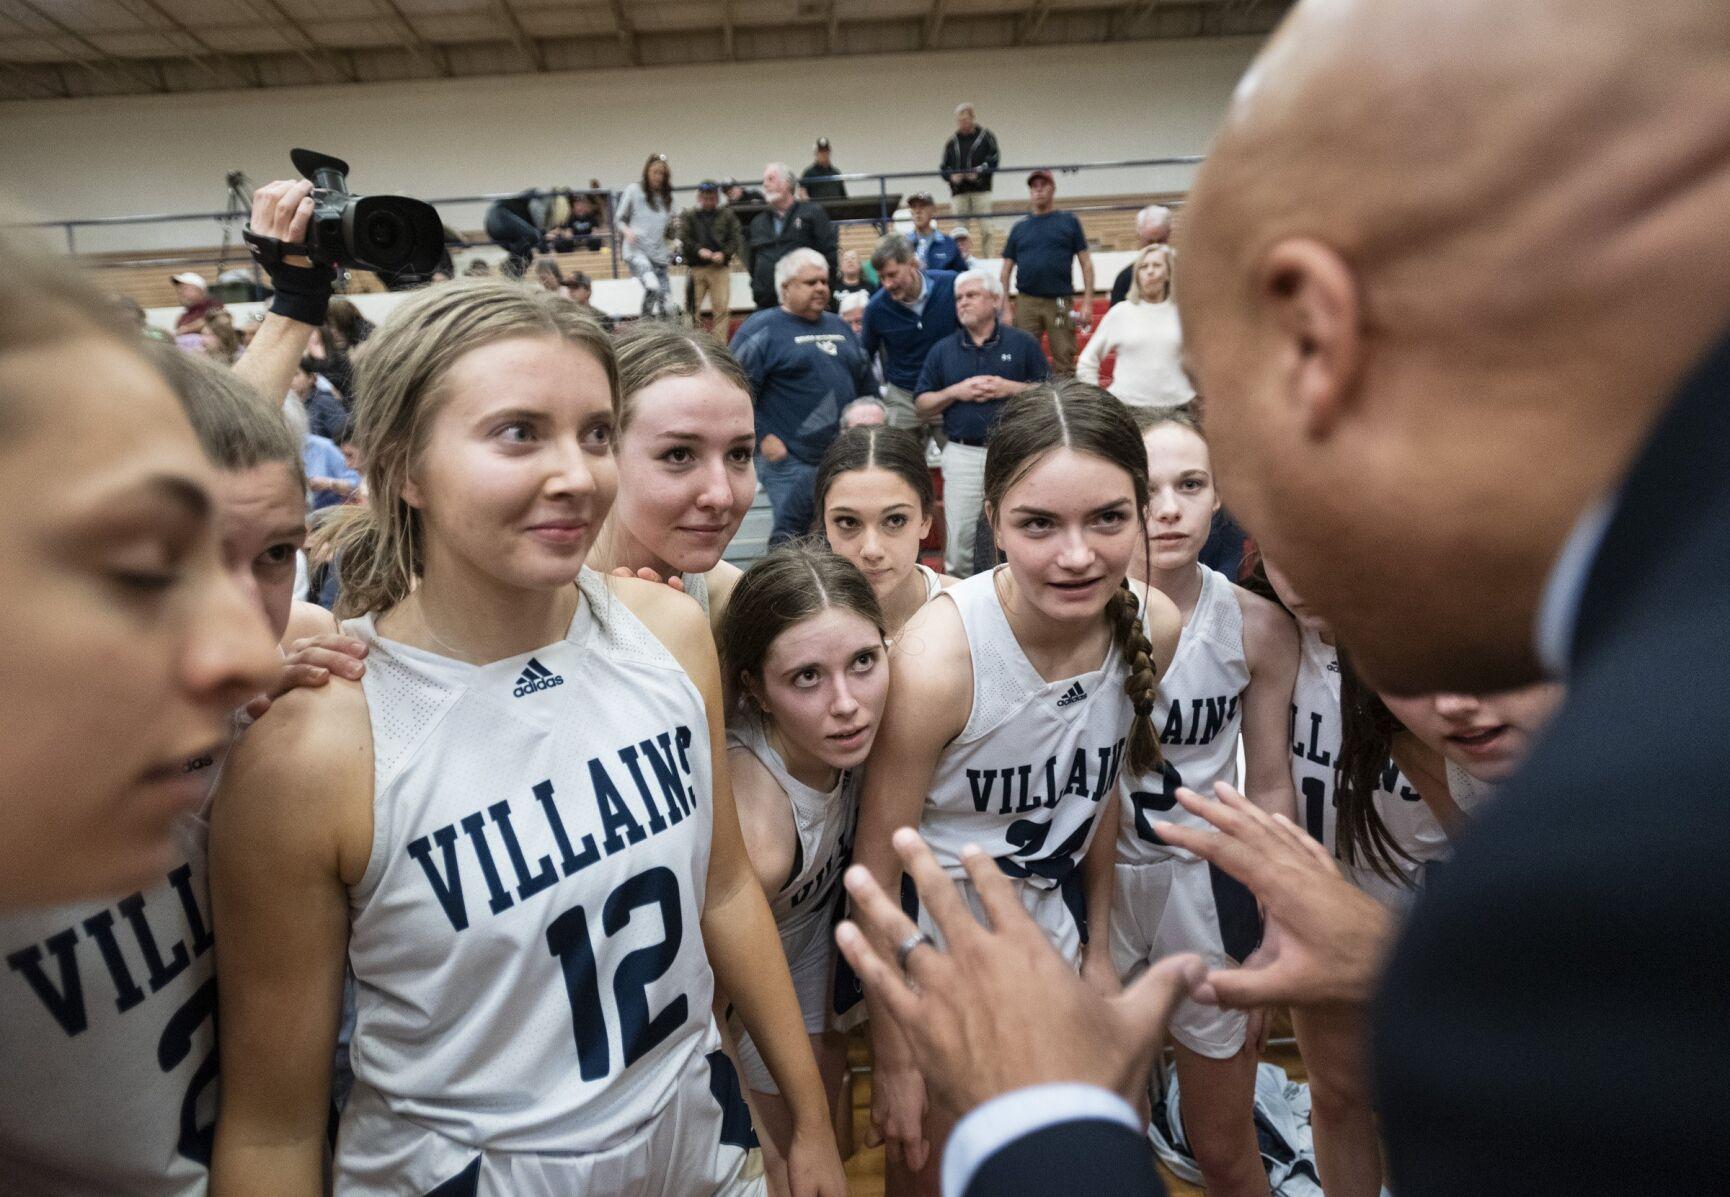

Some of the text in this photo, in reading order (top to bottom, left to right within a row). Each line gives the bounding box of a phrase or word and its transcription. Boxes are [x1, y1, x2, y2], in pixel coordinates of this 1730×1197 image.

[513, 675, 564, 698] adidas
[6, 863, 216, 1039] VILL
[546, 866, 689, 1083] 12
